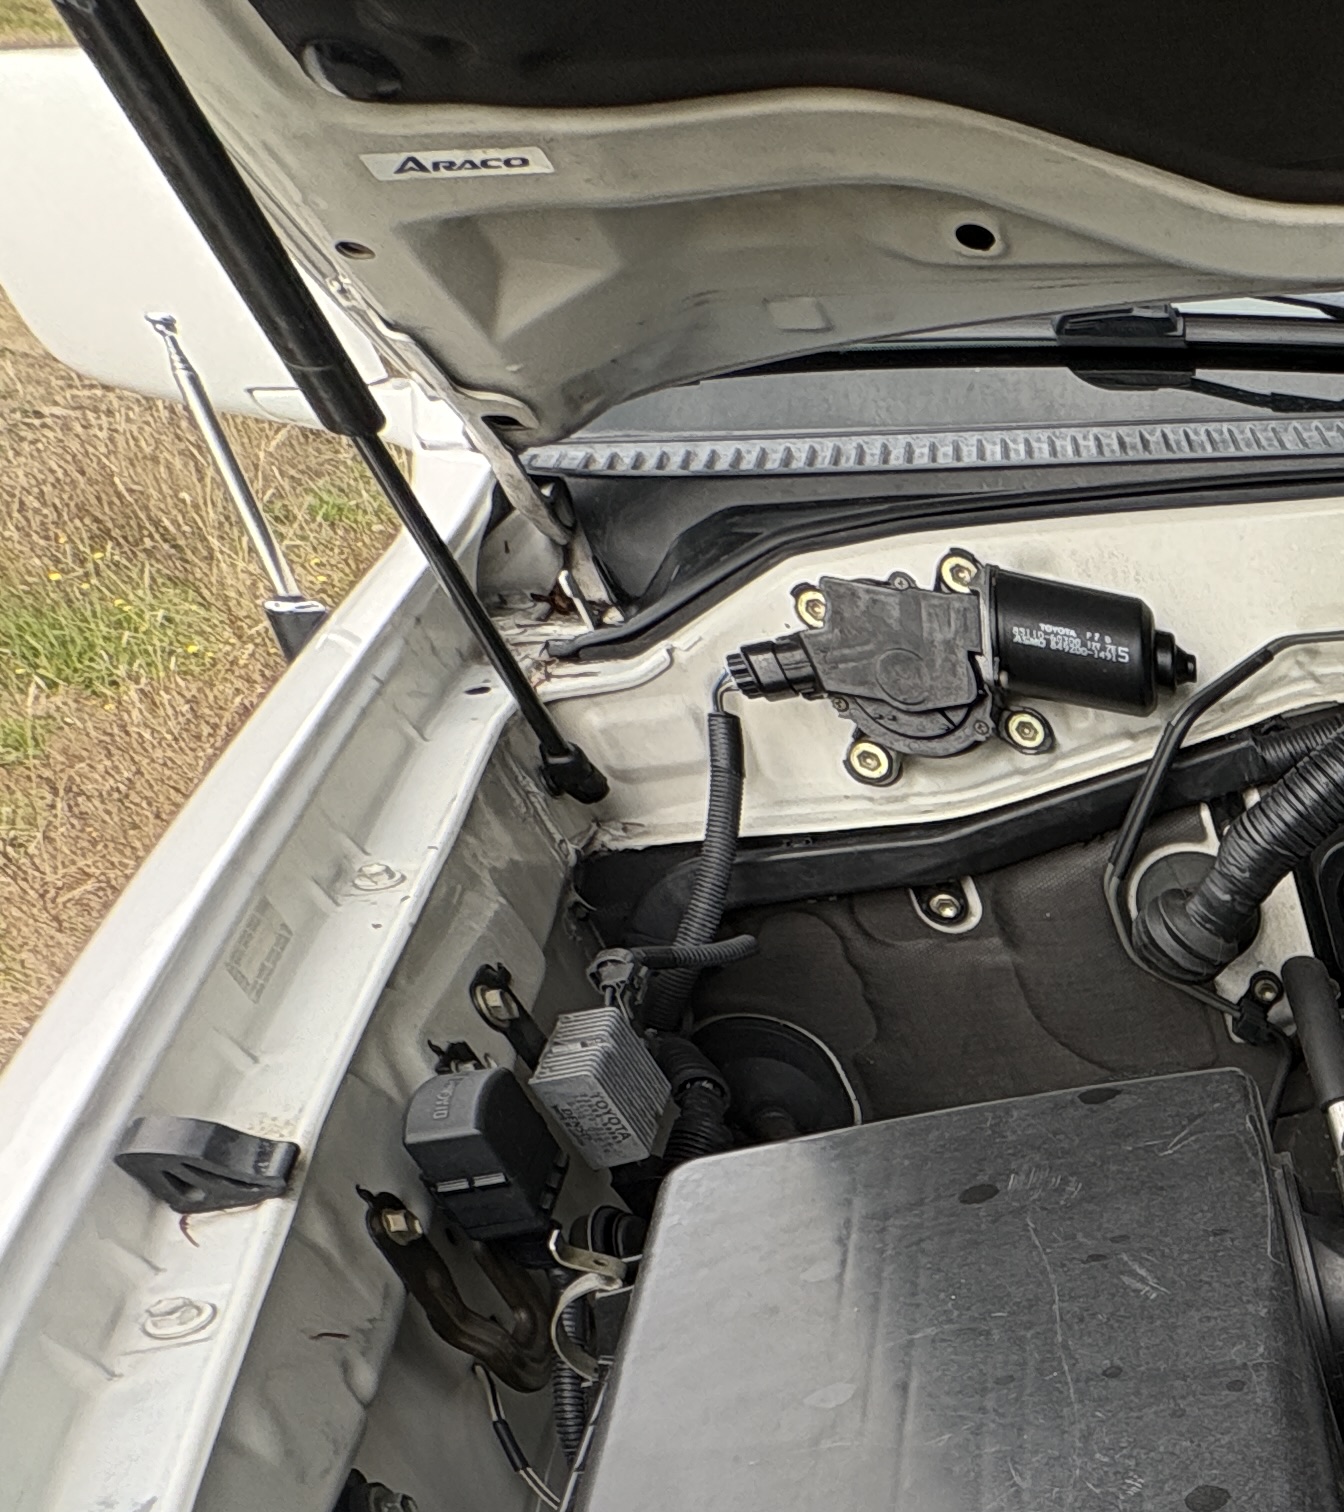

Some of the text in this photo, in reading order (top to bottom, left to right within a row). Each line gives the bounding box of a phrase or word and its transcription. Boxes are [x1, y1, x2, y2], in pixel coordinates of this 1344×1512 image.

[393, 155, 530, 174] ARACO
[1038, 622, 1077, 638] TOYOTA
[589, 1091, 632, 1141] TOYOTA
